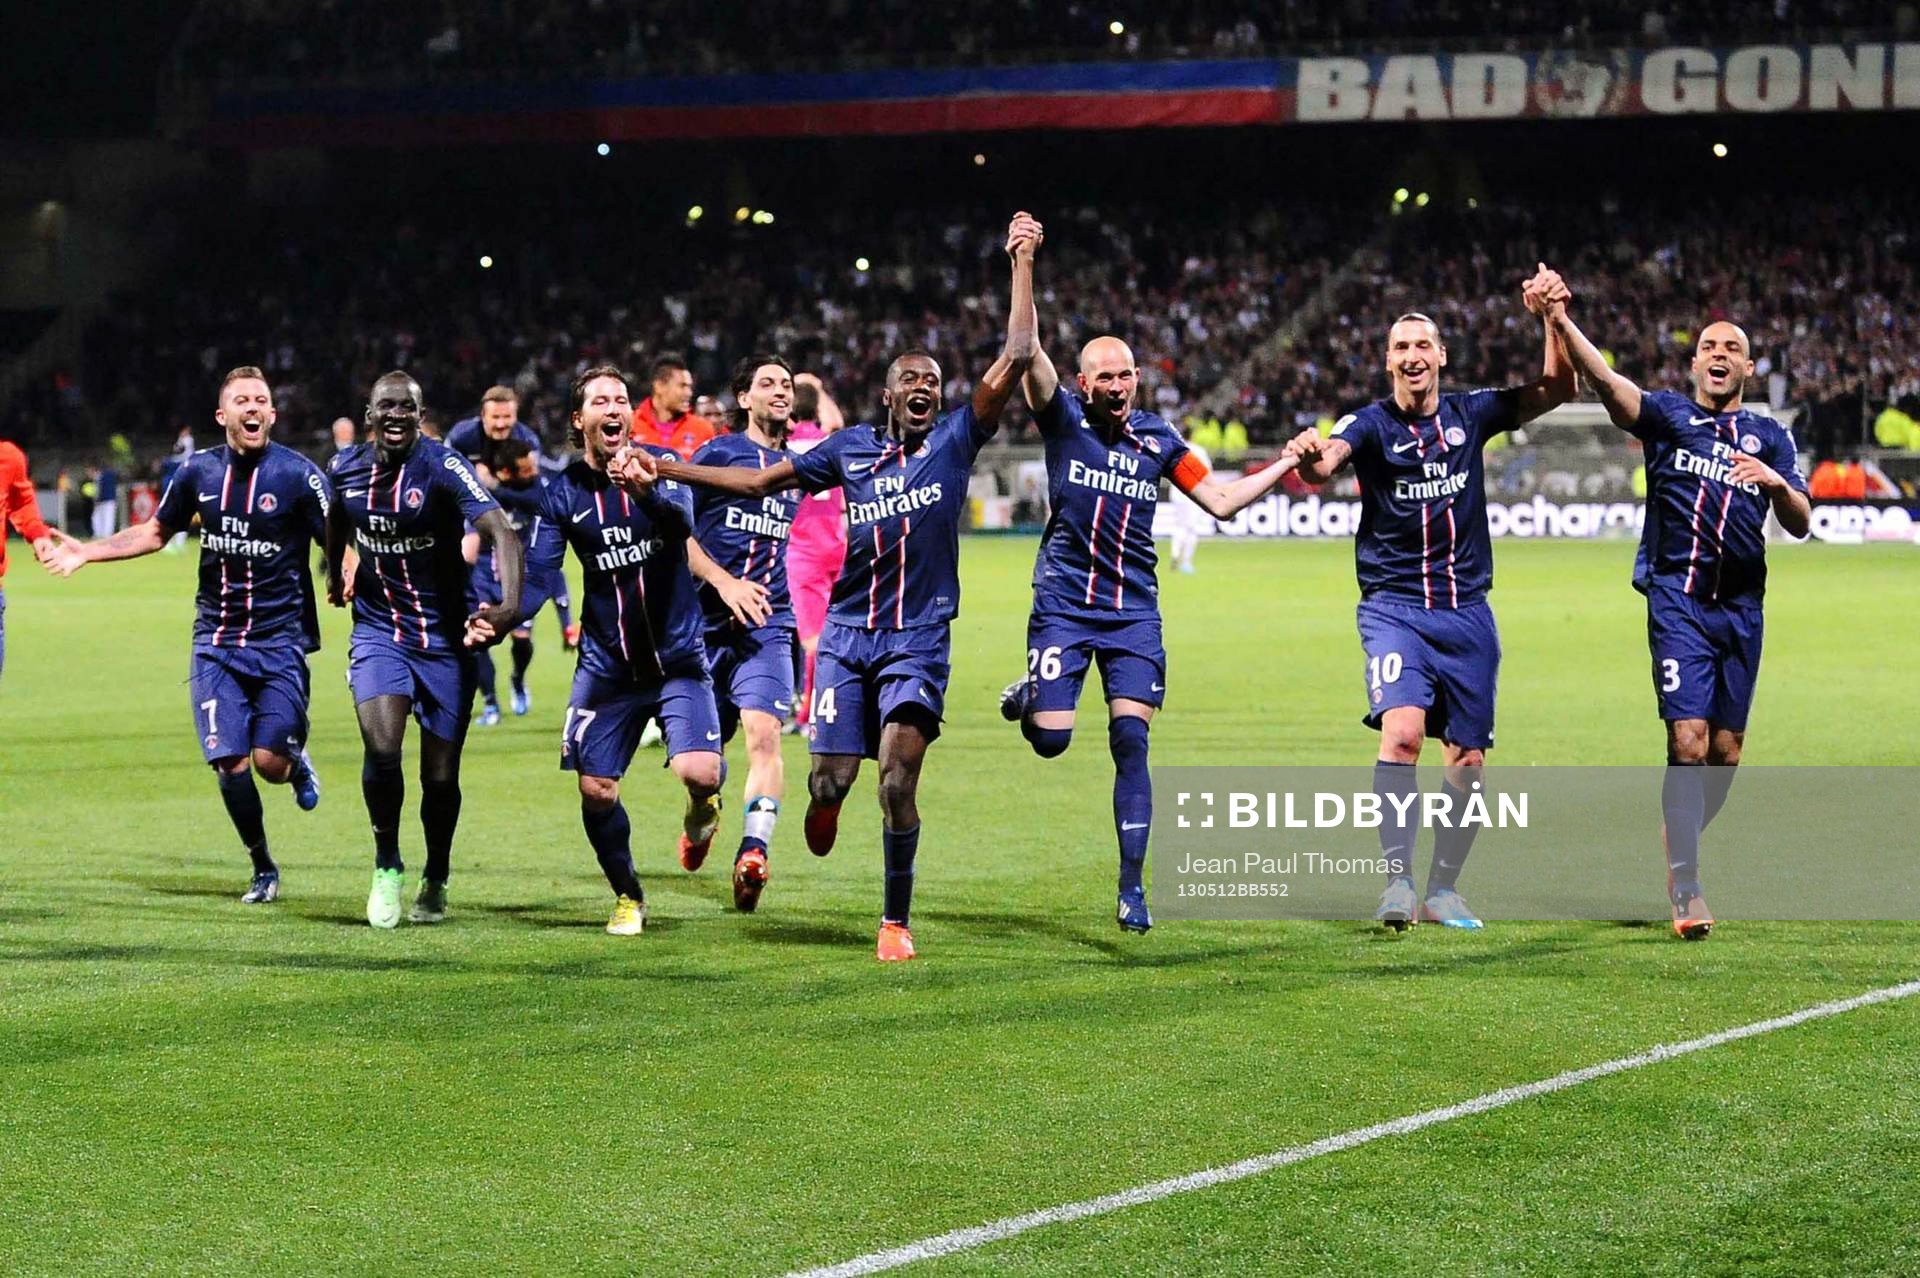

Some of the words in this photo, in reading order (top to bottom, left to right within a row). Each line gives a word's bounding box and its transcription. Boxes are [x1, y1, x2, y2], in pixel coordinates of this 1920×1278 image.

[1297, 53, 1529, 122] BAD
[1107, 450, 1139, 475] Fly
[1423, 461, 1448, 478] Fly
[874, 475, 905, 495] Fly
[1394, 469, 1469, 499] Emirate
[762, 496, 785, 519] Fly
[848, 482, 943, 525] Emirates
[221, 516, 250, 537] Fly
[368, 514, 398, 535] Fly
[601, 526, 632, 546] Fly
[1028, 646, 1062, 681] 26
[1370, 652, 1403, 690] 10
[1662, 658, 1681, 692] 3
[200, 699, 218, 734] 7
[562, 707, 597, 743] 17
